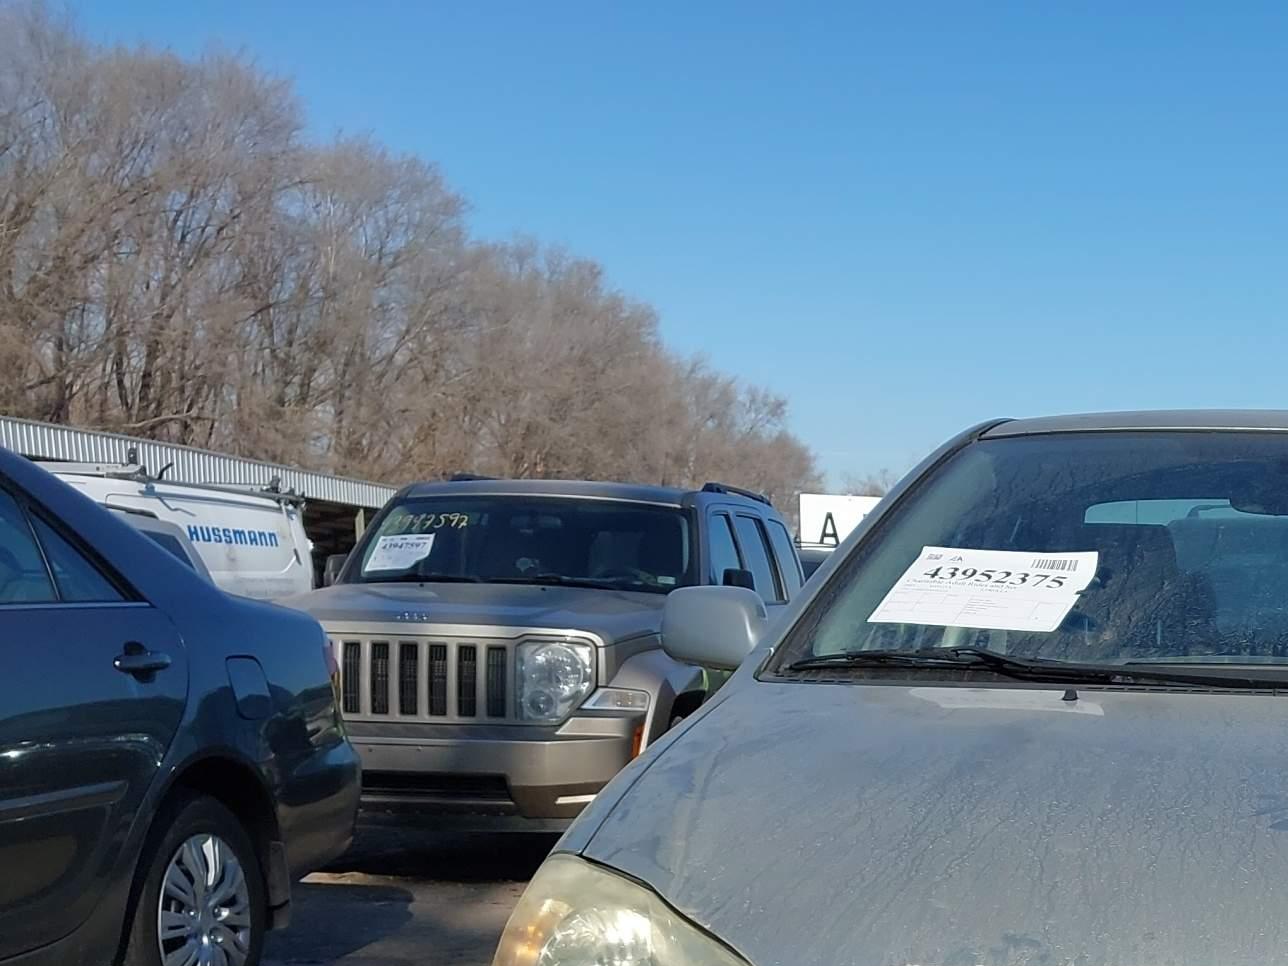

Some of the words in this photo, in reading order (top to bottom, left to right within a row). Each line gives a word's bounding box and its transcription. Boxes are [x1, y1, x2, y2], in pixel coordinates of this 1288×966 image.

[187, 525, 279, 547] HUSSMANN
[819, 511, 840, 545] A
[923, 566, 1068, 589] 43952375
